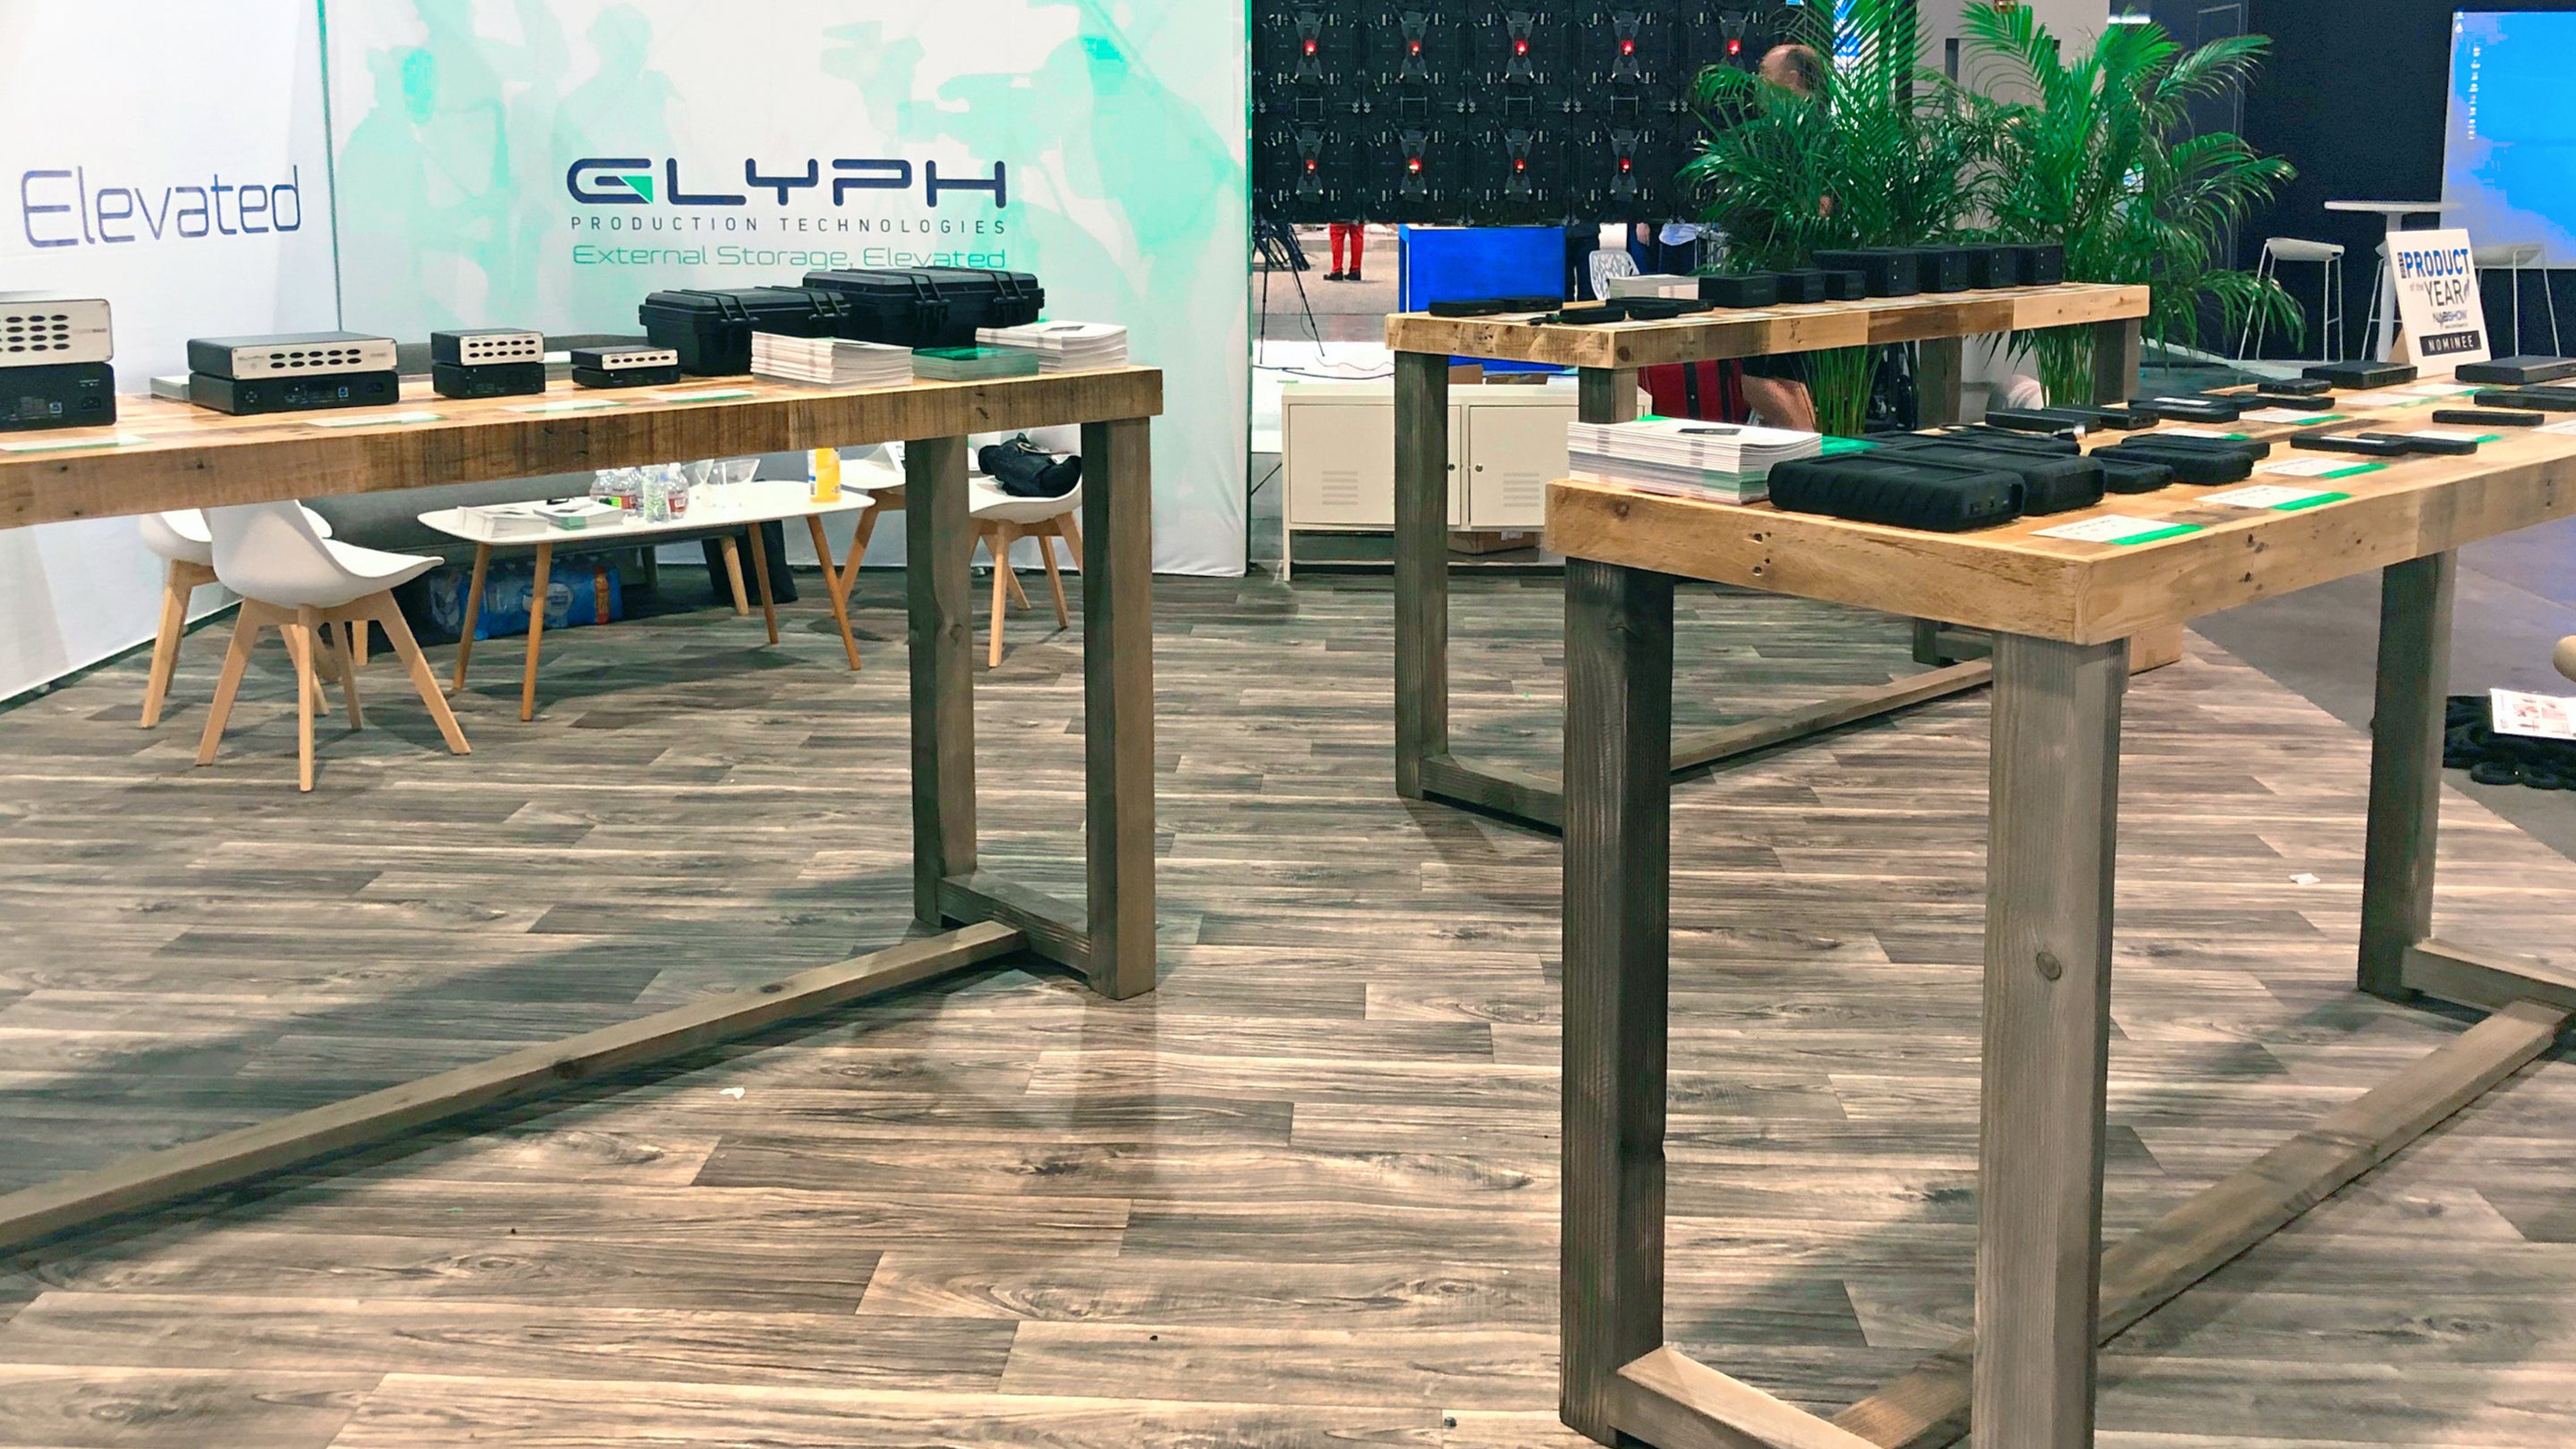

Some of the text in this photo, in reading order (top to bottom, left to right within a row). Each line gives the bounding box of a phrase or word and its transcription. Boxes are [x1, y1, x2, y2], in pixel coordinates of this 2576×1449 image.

[566, 157, 1005, 208] GLYPH
[20, 165, 301, 249] Elevated
[571, 216, 1005, 234] PRODUCTION TECHNOLOGIES
[572, 245, 1005, 271] External Storage, Elevated
[2403, 249, 2470, 278] PRODUCT
[2424, 279, 2465, 307] YEAR
[2428, 335, 2475, 352] NOMINEE
